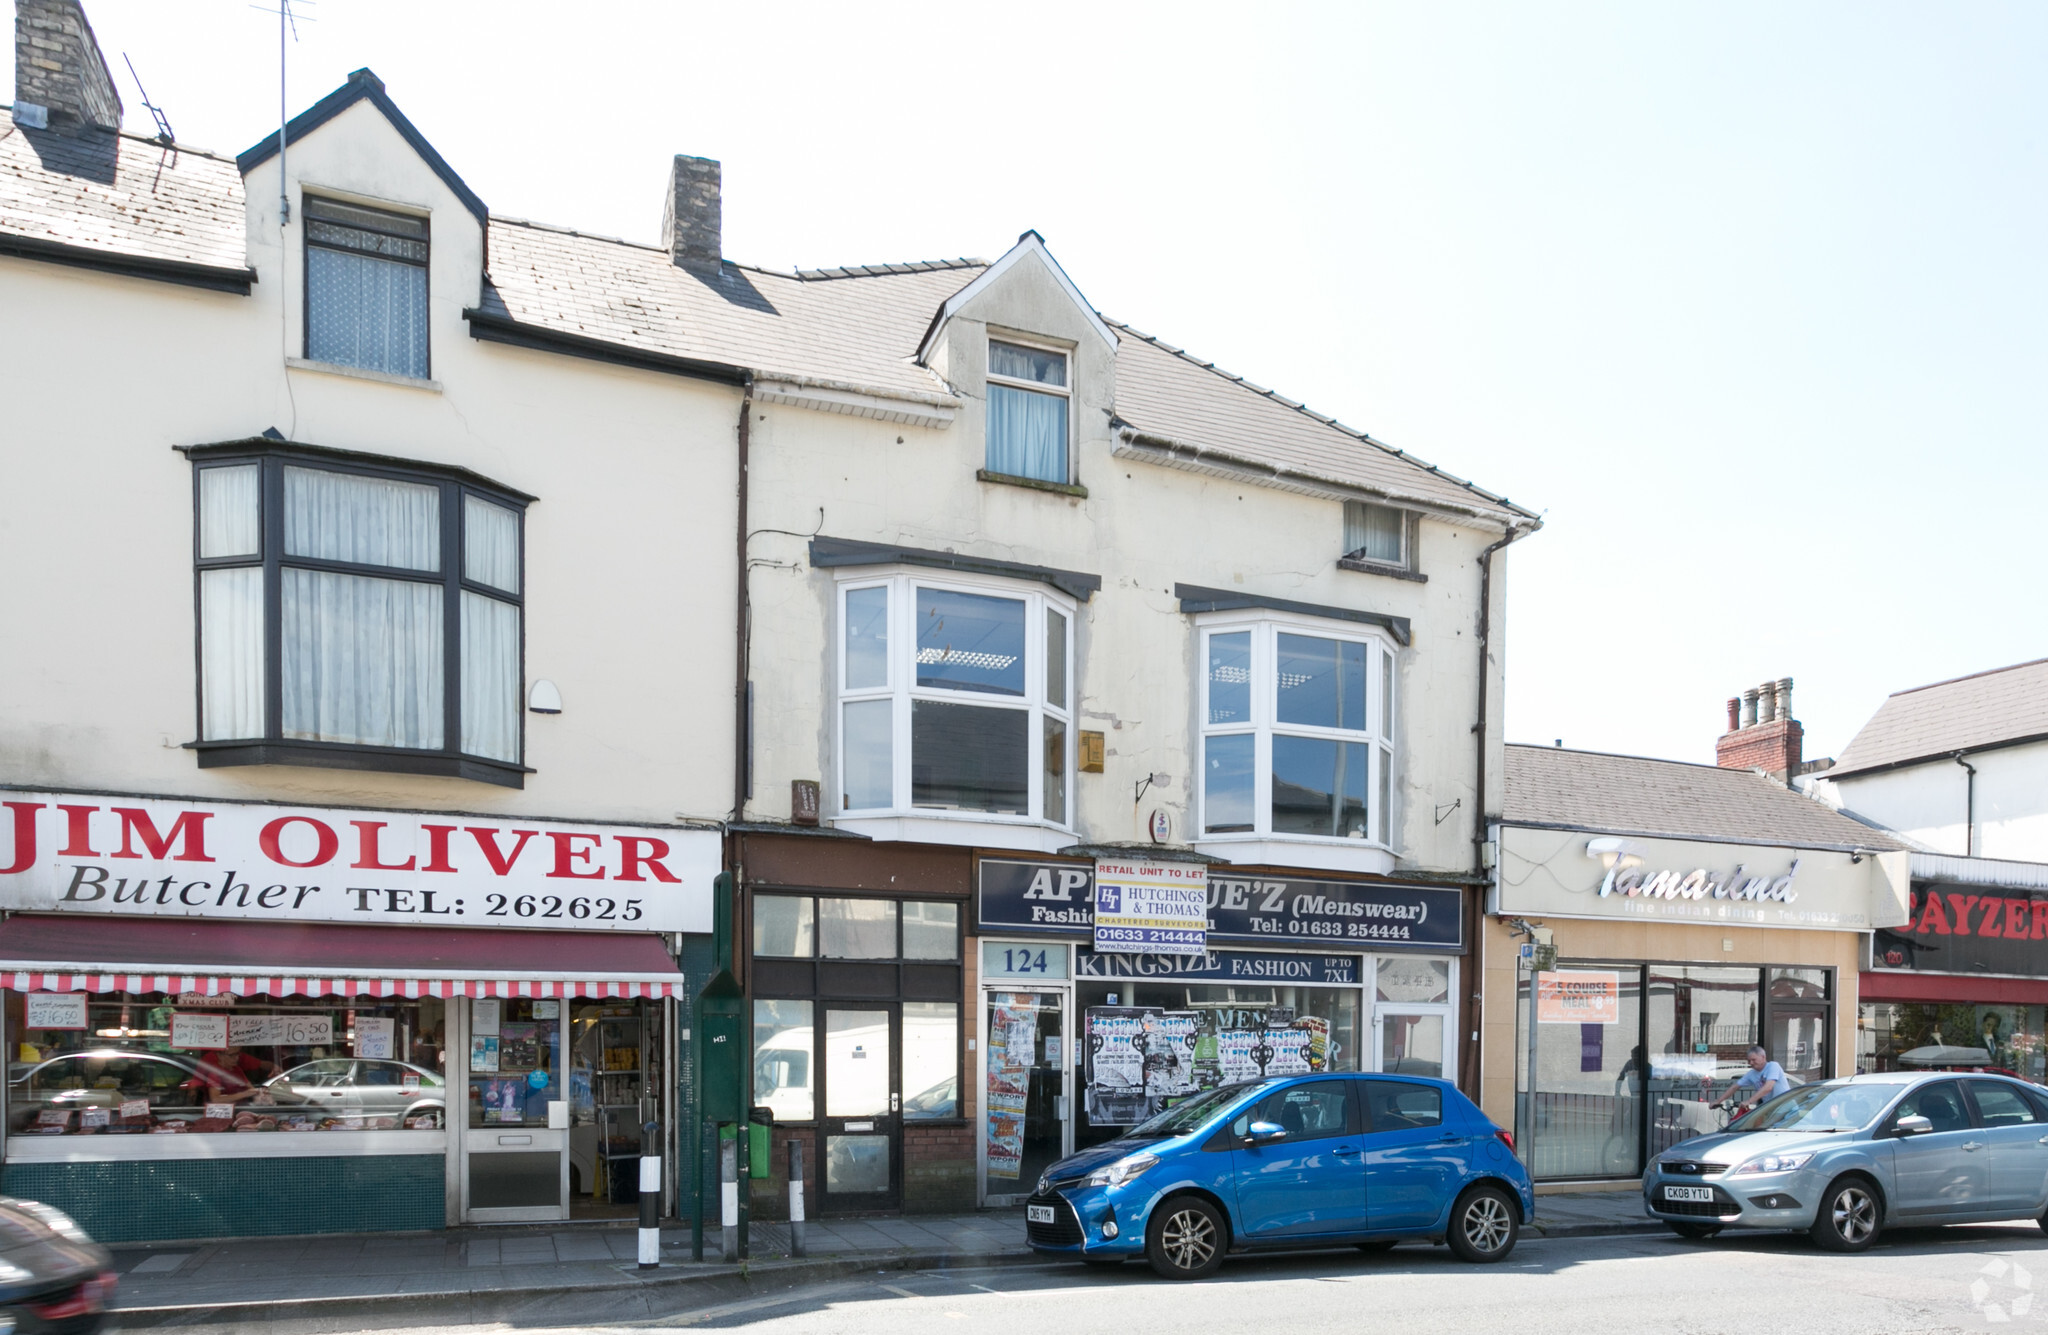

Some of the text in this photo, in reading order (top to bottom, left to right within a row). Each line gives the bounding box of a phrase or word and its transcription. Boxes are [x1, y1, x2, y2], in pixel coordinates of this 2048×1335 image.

[0, 802, 683, 883] JIM OLIVER
[1098, 865, 1204, 879] RETAIL UNIT TO LET
[1586, 837, 1798, 904] Tamarind
[59, 864, 644, 921] Butcher TEL: 262625
[1128, 887, 1204, 903] HUTCHINGS
[1134, 902, 1200, 917] & THOMAS
[1292, 894, 1428, 925] (Menswear)
[1624, 900, 1655, 914] fine
[1661, 903, 1710, 917] indian
[1718, 903, 1765, 921] dining
[1097, 916, 1205, 929] CHARTERED SURVEYORS
[1250, 917, 1283, 934] Tel:
[1289, 920, 1343, 936] 01633
[1348, 922, 1410, 939] 254444
[1097, 928, 1204, 943] 01633 214444
[1003, 948, 1047, 973] 124
[1078, 950, 1352, 977] KINGSIZE FASHION UP TO
[1885, 951, 1903, 965] 120
[1324, 969, 1353, 983] 7XL
[1557, 982, 1563, 994] 5
[1566, 982, 1608, 995] COURSE
[1561, 995, 1591, 1008] MEAL
[1667, 1187, 1710, 1200] CK08 YTU
